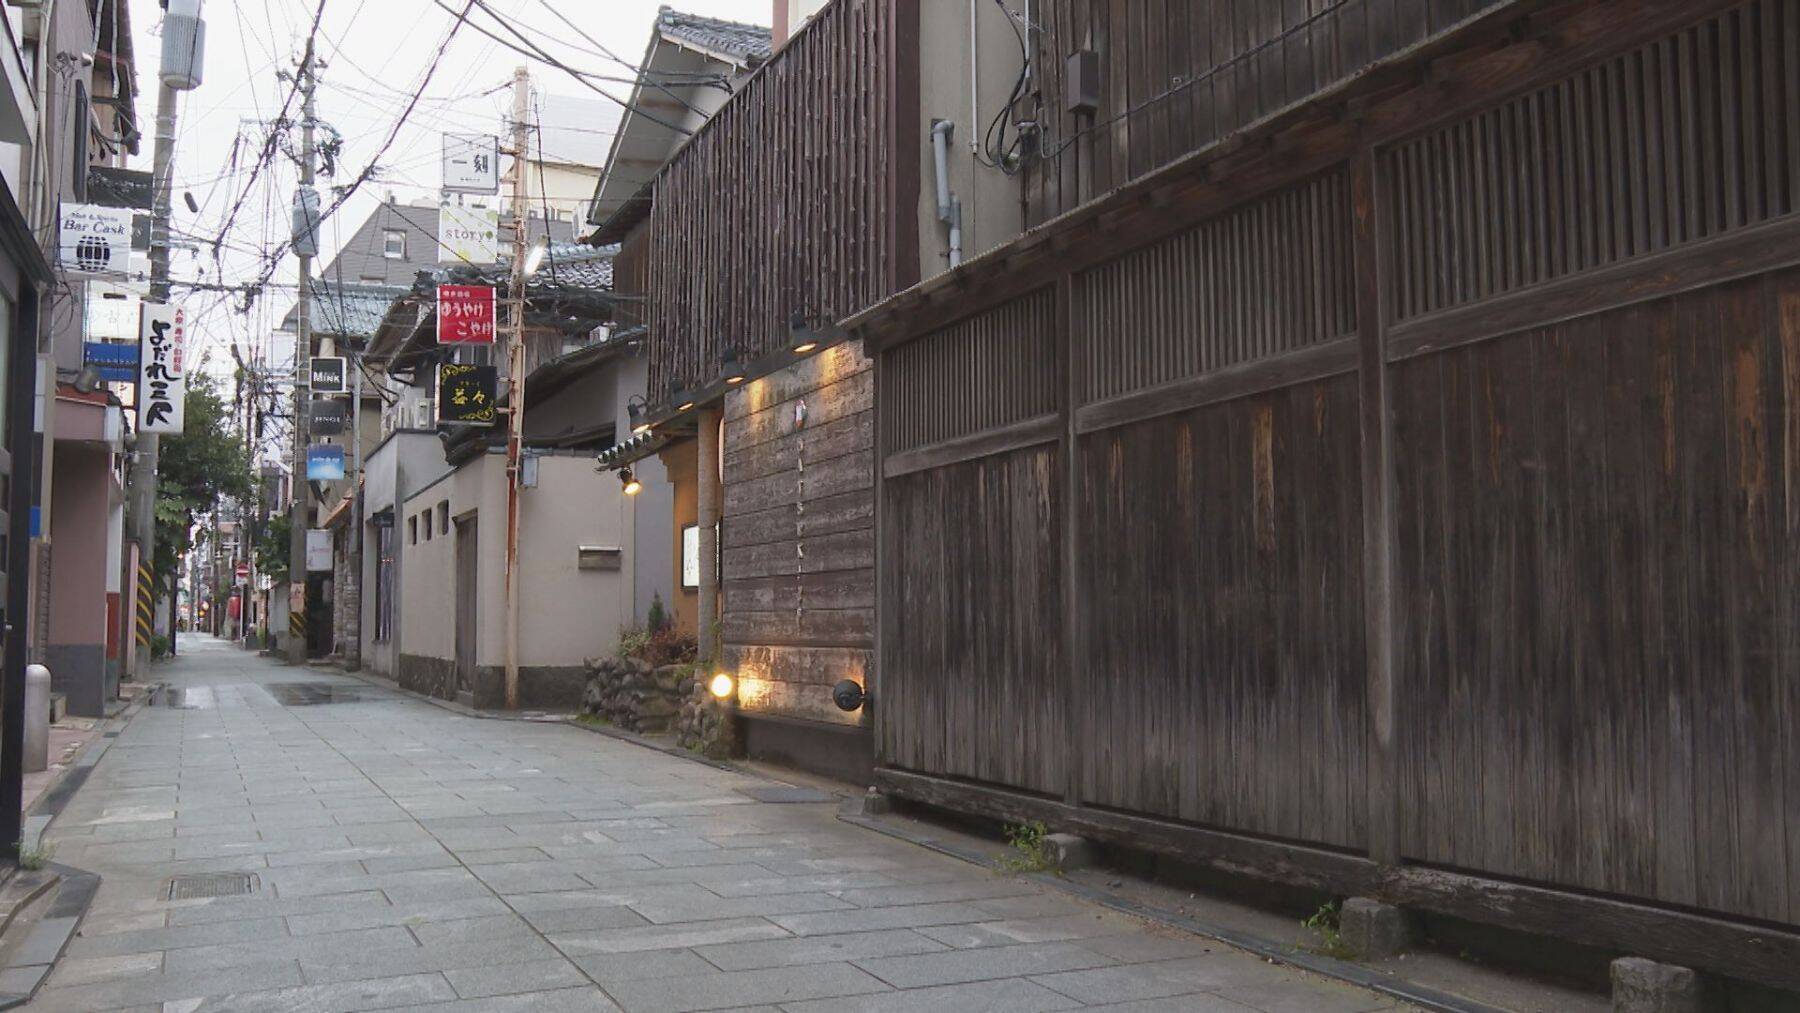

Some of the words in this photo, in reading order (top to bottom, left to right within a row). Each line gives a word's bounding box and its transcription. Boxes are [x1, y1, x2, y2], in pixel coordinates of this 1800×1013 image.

[452, 154, 489, 174] 一刻
[63, 219, 88, 231] Bar
[93, 220, 126, 235] Cask
[445, 228, 485, 244] story
[441, 301, 484, 318] ゆうやけ
[456, 321, 492, 336] こやけ
